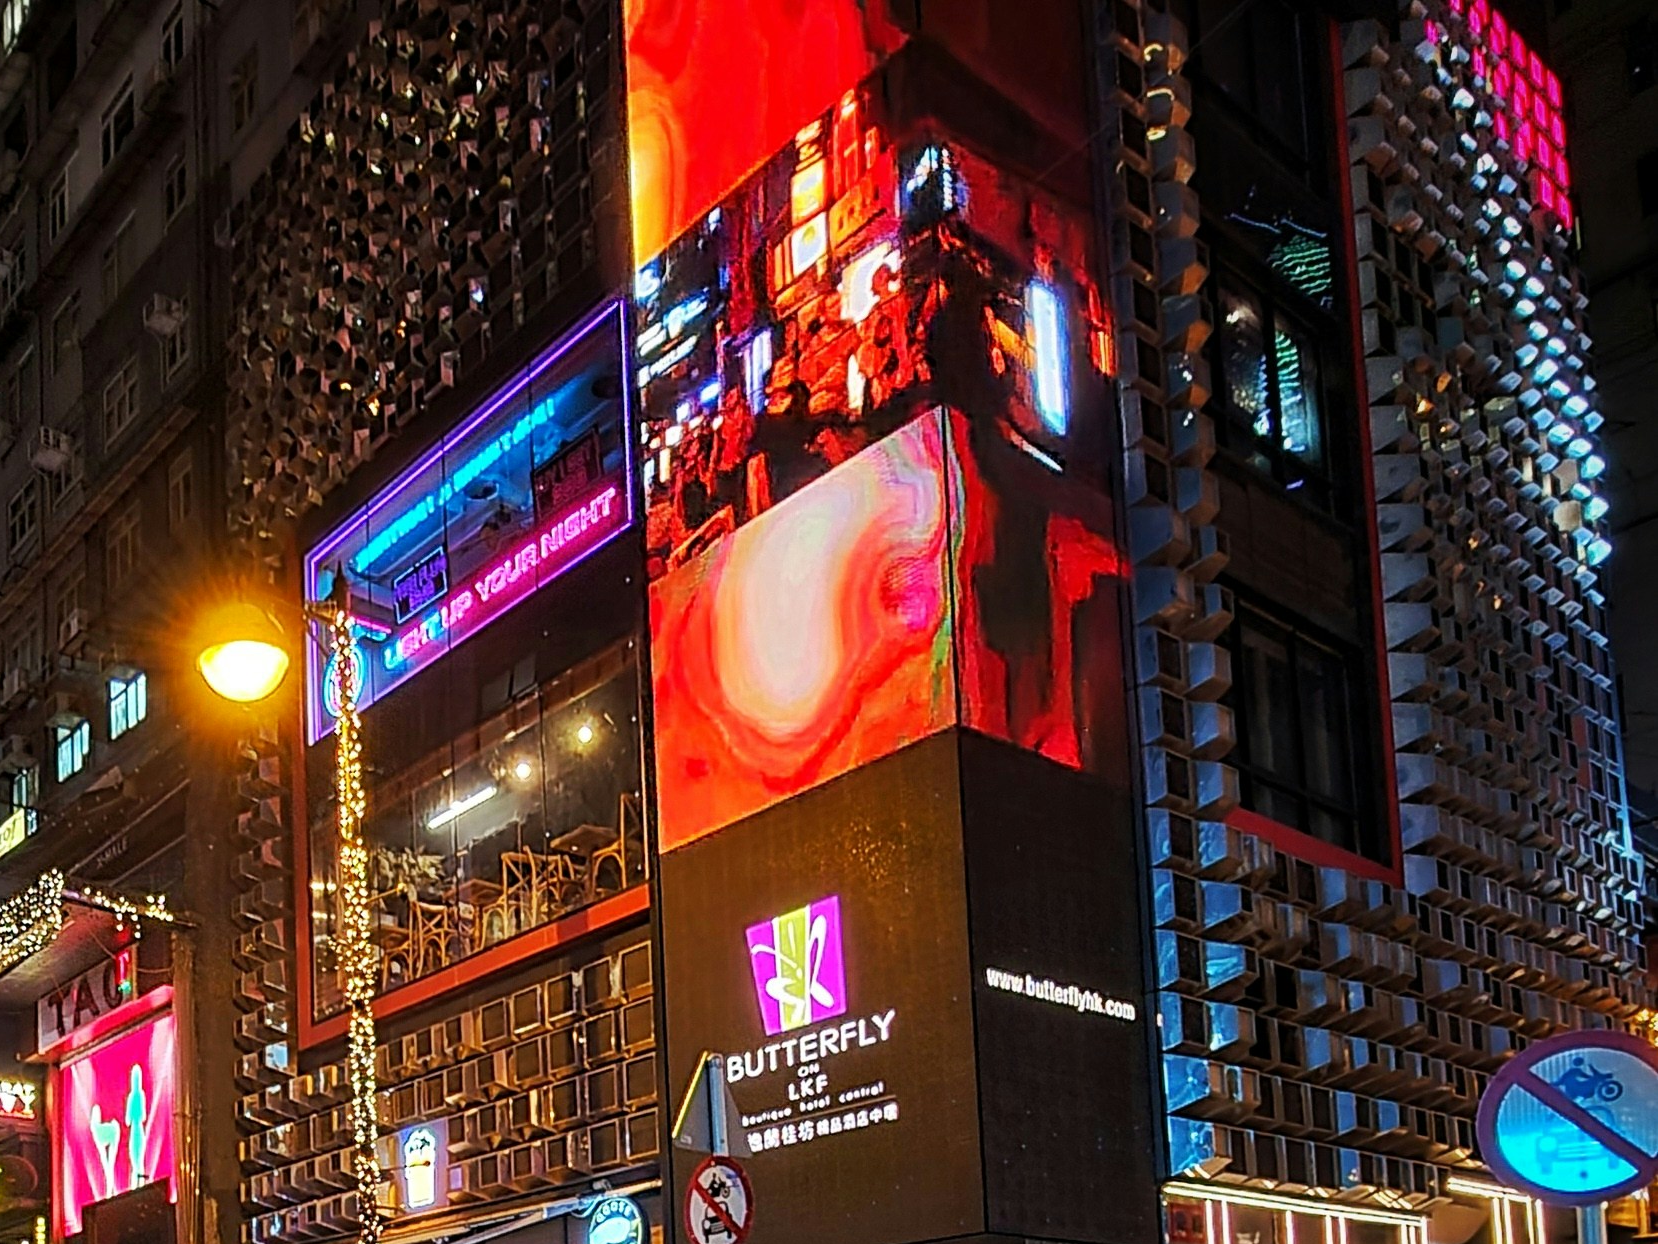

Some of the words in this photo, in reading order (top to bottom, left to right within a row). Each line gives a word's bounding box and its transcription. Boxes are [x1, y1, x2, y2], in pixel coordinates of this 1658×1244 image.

[383, 611, 442, 670] LIGHT
[441, 590, 473, 628] UP
[474, 543, 540, 602] YOUR
[541, 487, 616, 558] NIGHT
[986, 967, 1136, 1021] www.butterflyhk.com
[726, 1008, 896, 1084] BUTTERFLY
[798, 1063, 820, 1078] ON
[788, 1074, 829, 1101] LKF
[799, 1096, 831, 1113] hotel
[596, 1200, 633, 1223] GOOSE
